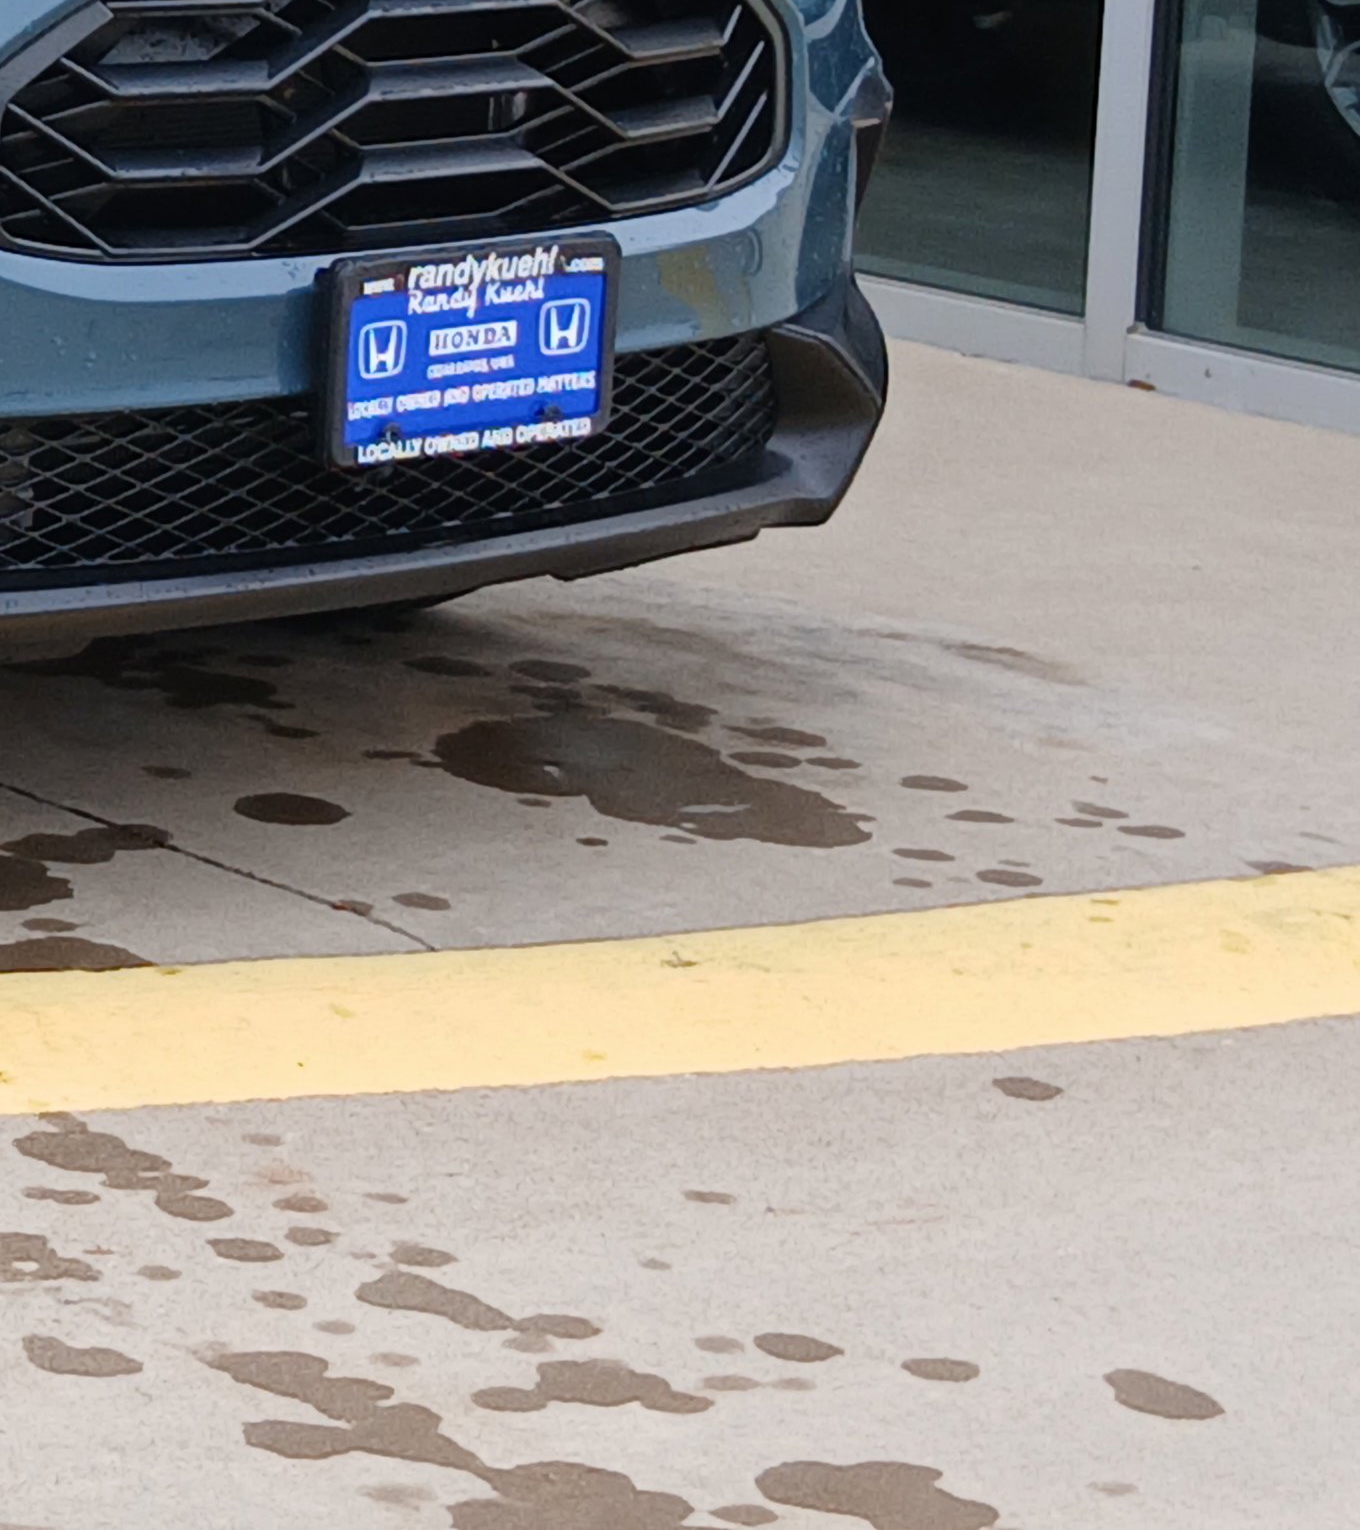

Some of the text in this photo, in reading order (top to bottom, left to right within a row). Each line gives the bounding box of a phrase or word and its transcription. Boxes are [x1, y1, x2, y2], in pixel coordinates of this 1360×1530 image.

[408, 244, 559, 290] randykuehl
[408, 285, 478, 318] Randy
[485, 278, 545, 306] Kuehl
[433, 325, 512, 351] HONDA
[358, 417, 591, 463] LOCALLY OWNED AND OPERATED
